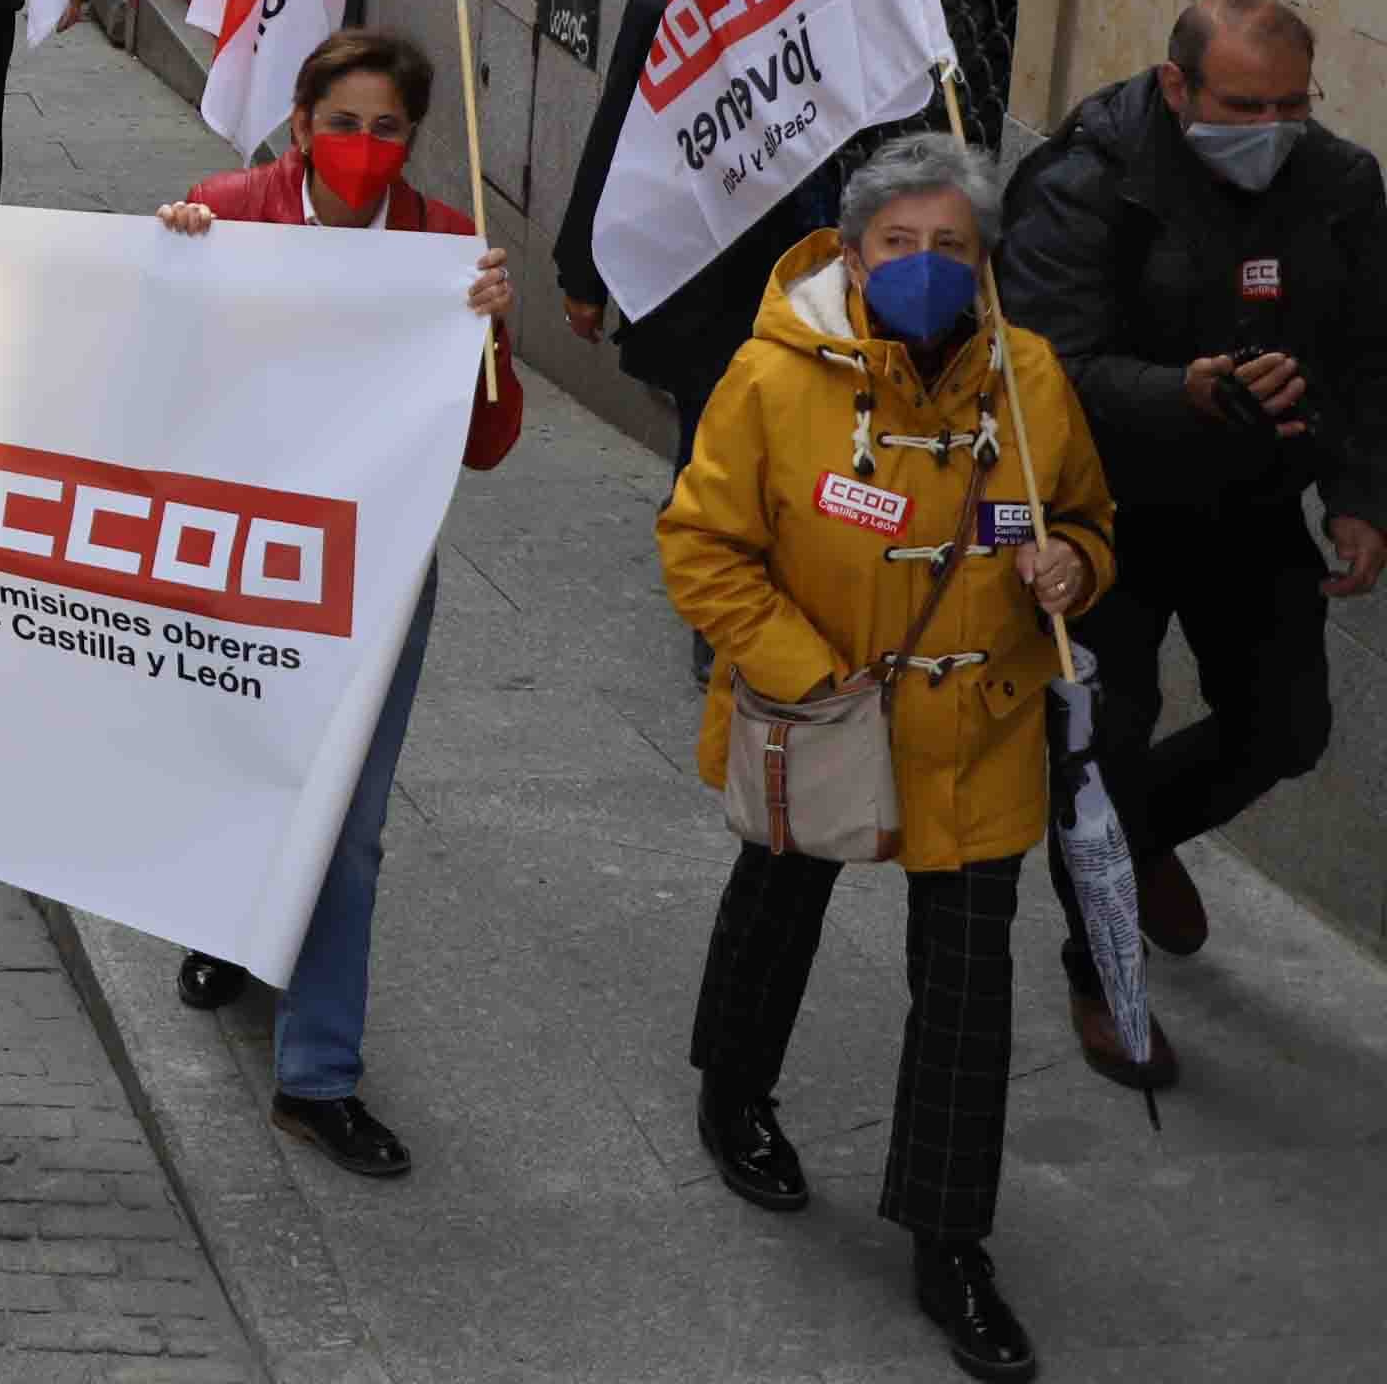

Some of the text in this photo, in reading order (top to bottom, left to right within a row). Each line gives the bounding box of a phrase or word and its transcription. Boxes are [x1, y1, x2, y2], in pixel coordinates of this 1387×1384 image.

[1246, 265, 1275, 281] CC
[830, 481, 899, 515] CCOO
[818, 499, 858, 520] Castilla
[869, 516, 898, 534] León
[12, 612, 136, 667] Castilla
[146, 651, 166, 679] y
[177, 657, 263, 700] León
[162, 620, 302, 670] obreras
